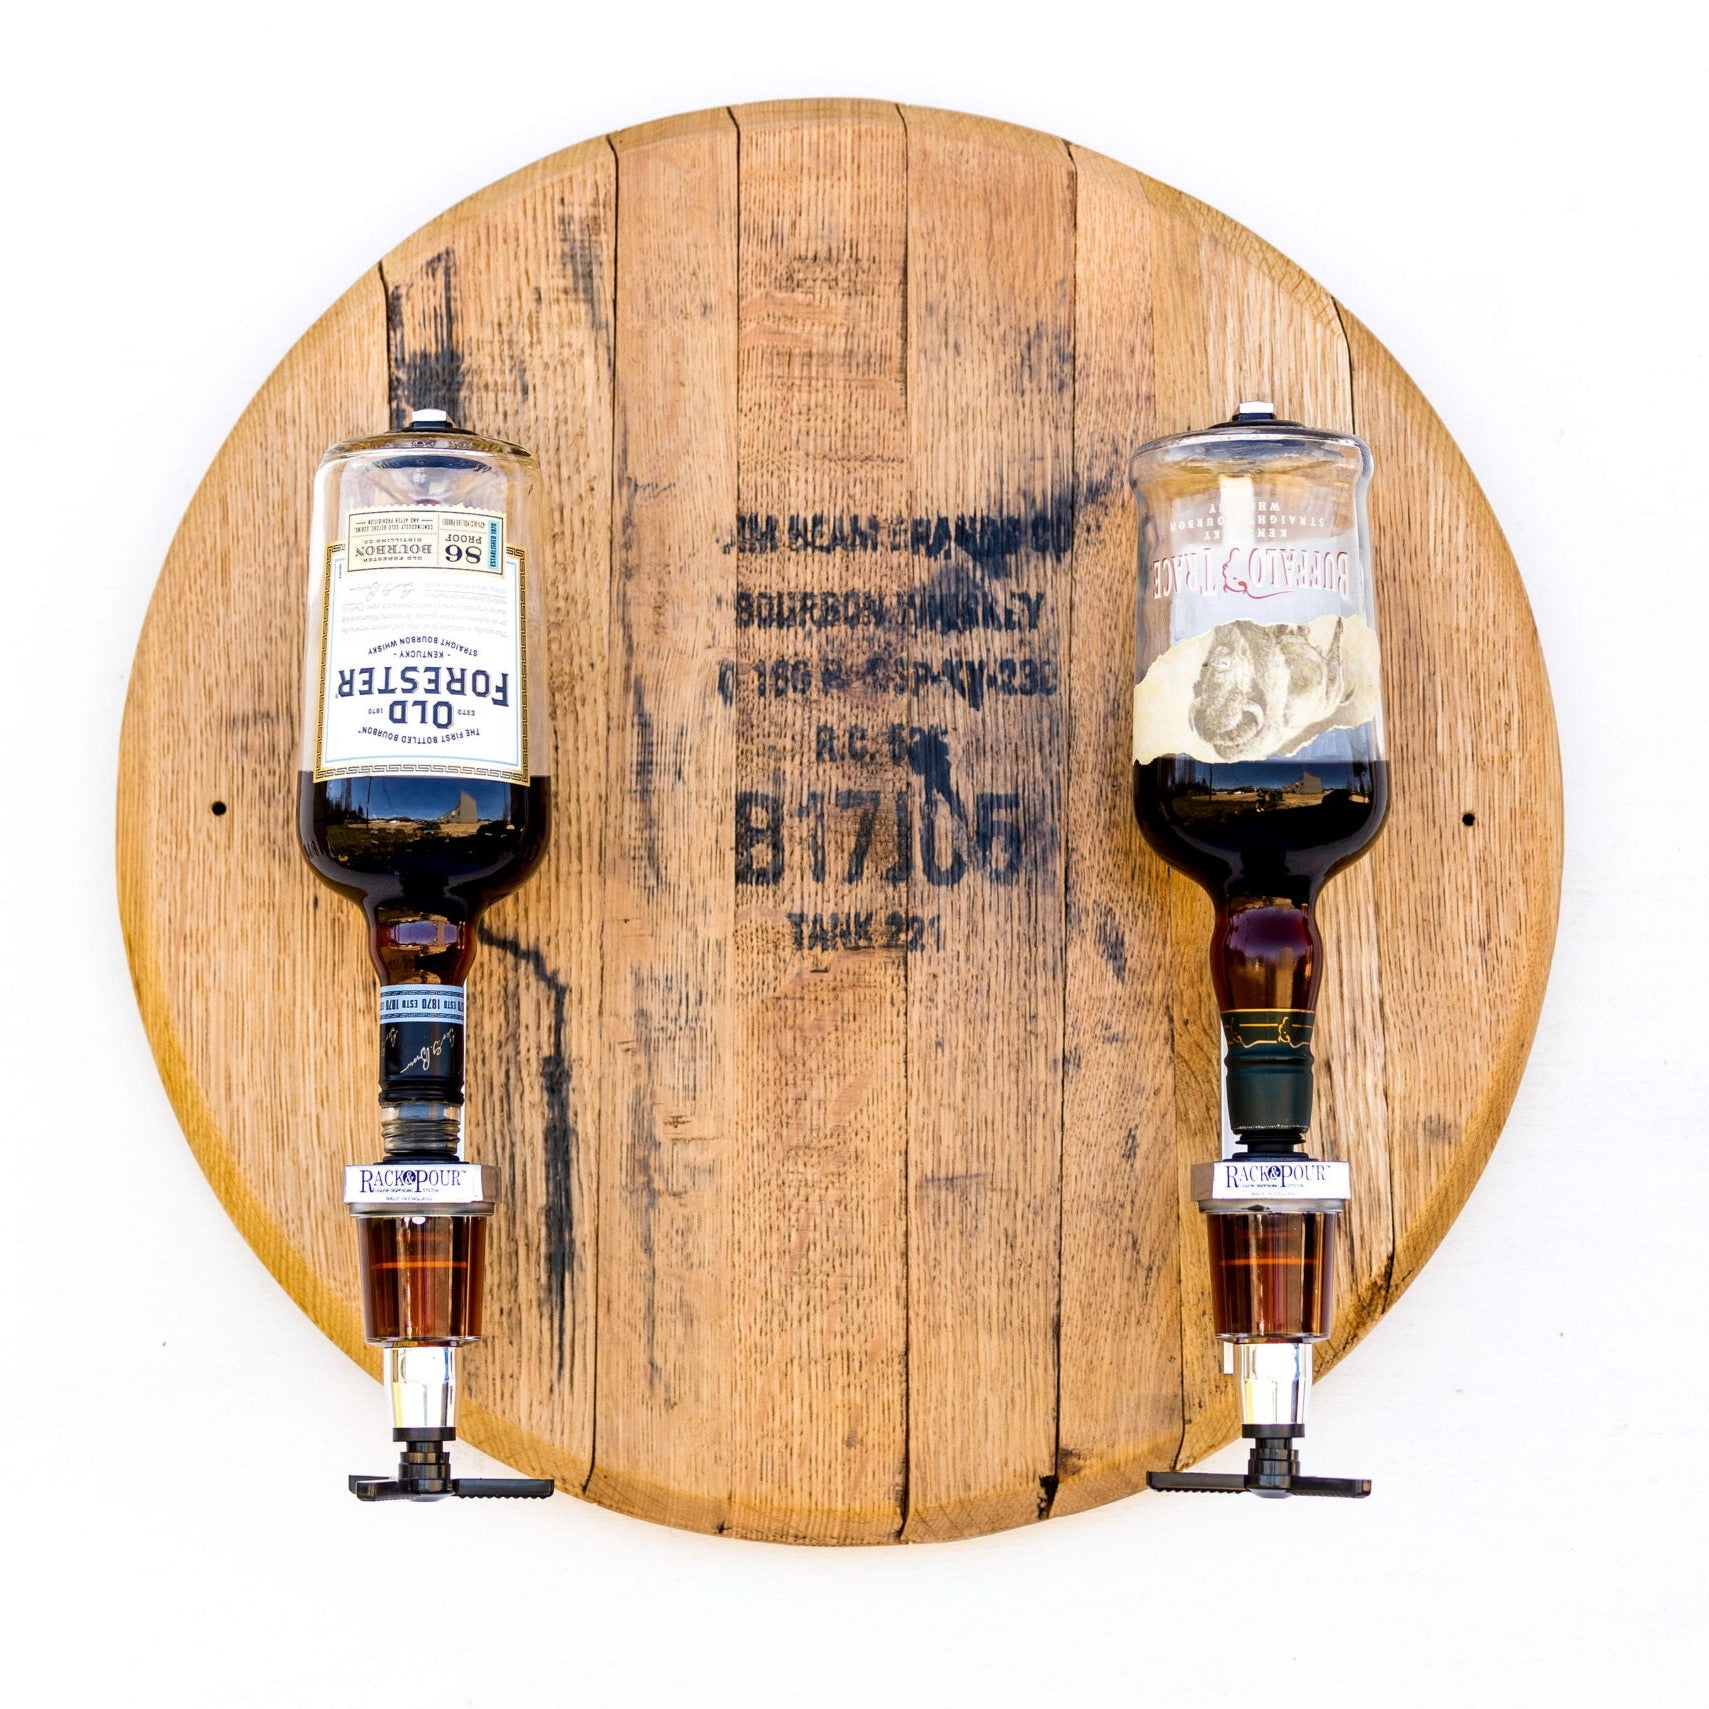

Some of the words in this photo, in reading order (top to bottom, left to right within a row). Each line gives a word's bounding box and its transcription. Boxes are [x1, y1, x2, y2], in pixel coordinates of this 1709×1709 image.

[445, 533, 482, 545] PROOF
[355, 544, 432, 557] BOURBON
[445, 544, 482, 564] 86
[1152, 547, 1218, 600] TRACE
[1248, 547, 1351, 600] BUFFALO
[735, 589, 886, 631] BOURBON
[368, 640, 398, 655] WHISKY
[400, 635, 438, 645] BOURBON
[440, 638, 478, 657] STRAIGHT
[400, 651, 444, 659] KENTUCKY
[337, 666, 510, 707] FORESTER
[389, 700, 454, 729] OLD
[401, 735, 438, 745] BOTTLED
[441, 729, 463, 743] FIRST
[466, 728, 480, 737] THE
[786, 911, 874, 952] TANK
[421, 998, 440, 1010] 1870
